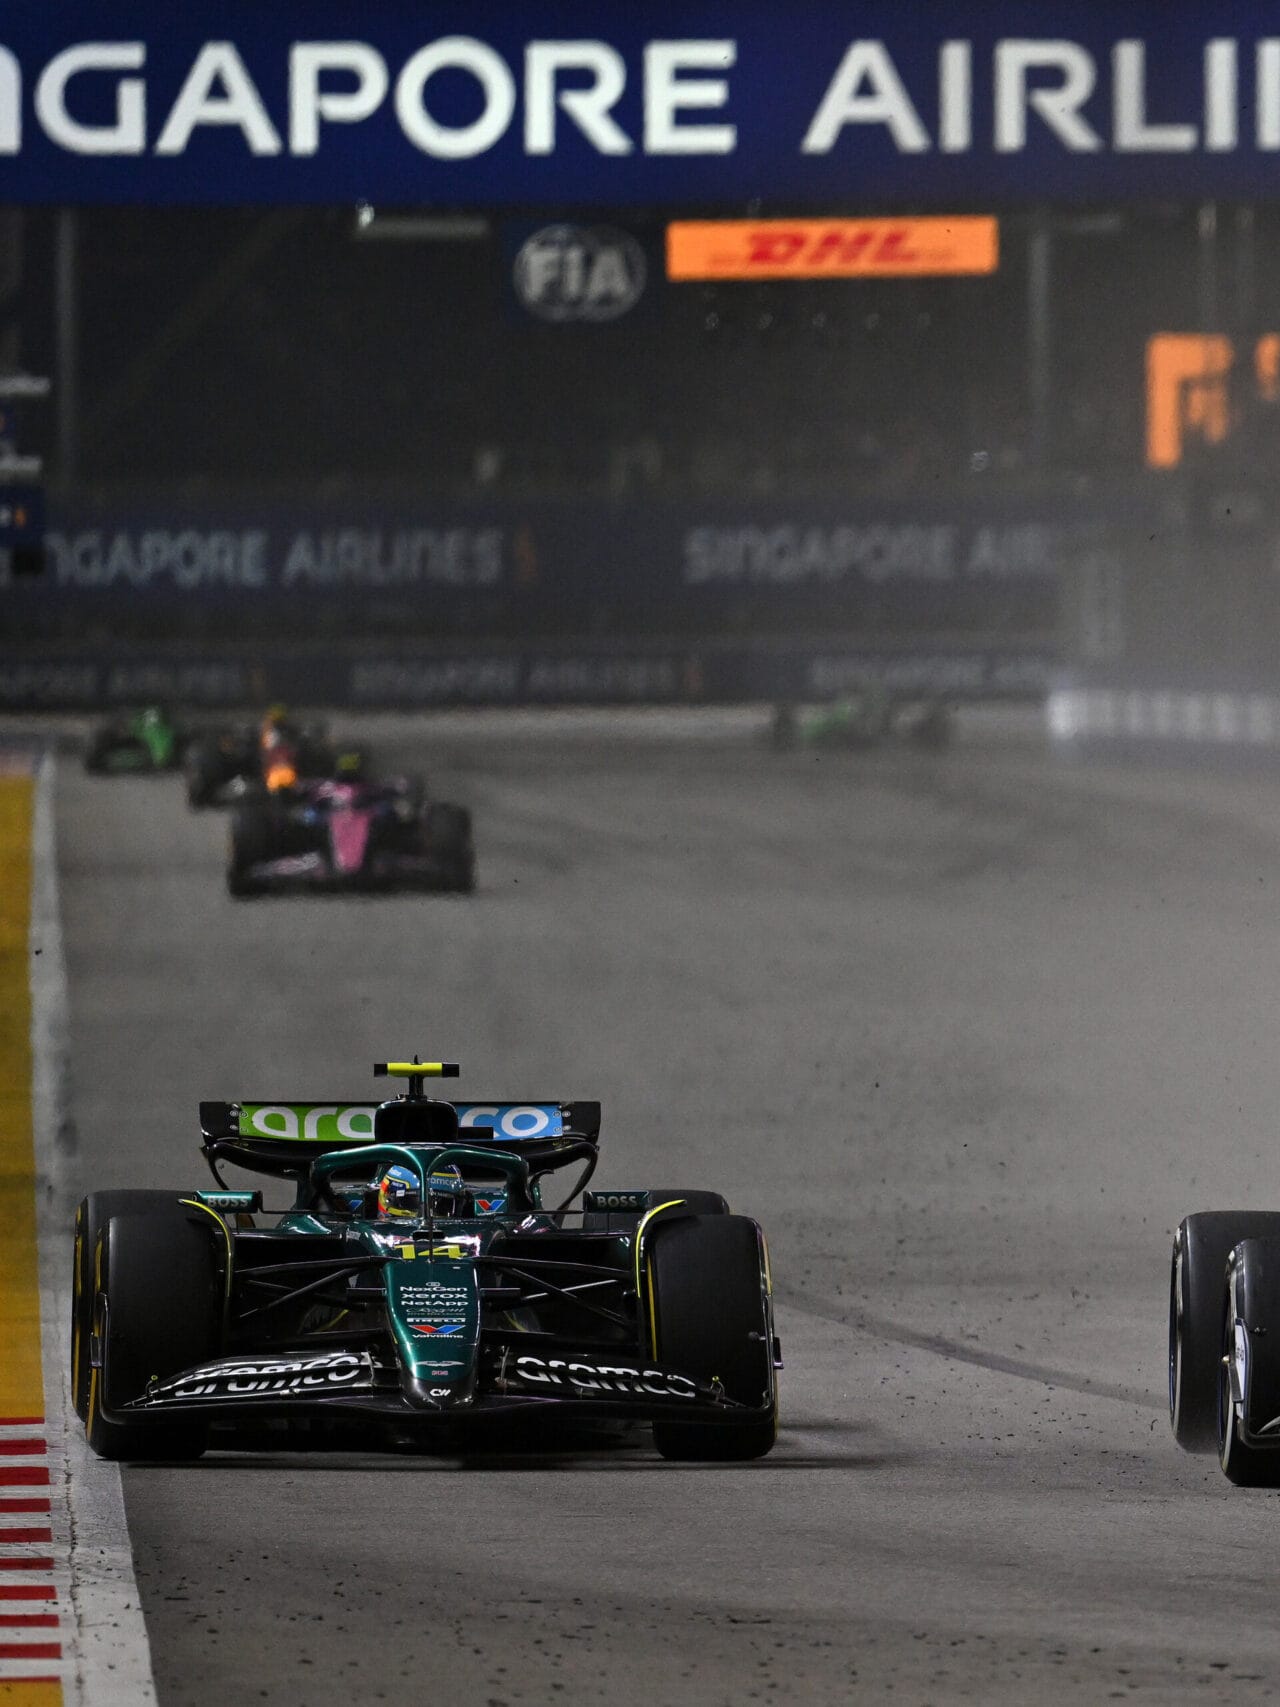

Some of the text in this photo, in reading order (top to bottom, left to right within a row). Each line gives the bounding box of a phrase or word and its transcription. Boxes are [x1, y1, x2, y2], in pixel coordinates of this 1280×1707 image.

[0, 36, 736, 159] GAPORE
[748, 232, 918, 264] DHL
[523, 244, 631, 301] FIA
[252, 1106, 549, 1138] araco
[207, 1195, 248, 1207] BOSS
[597, 1196, 637, 1207] BOSS
[394, 1244, 468, 1259] 14
[516, 1356, 696, 1398] aramco
